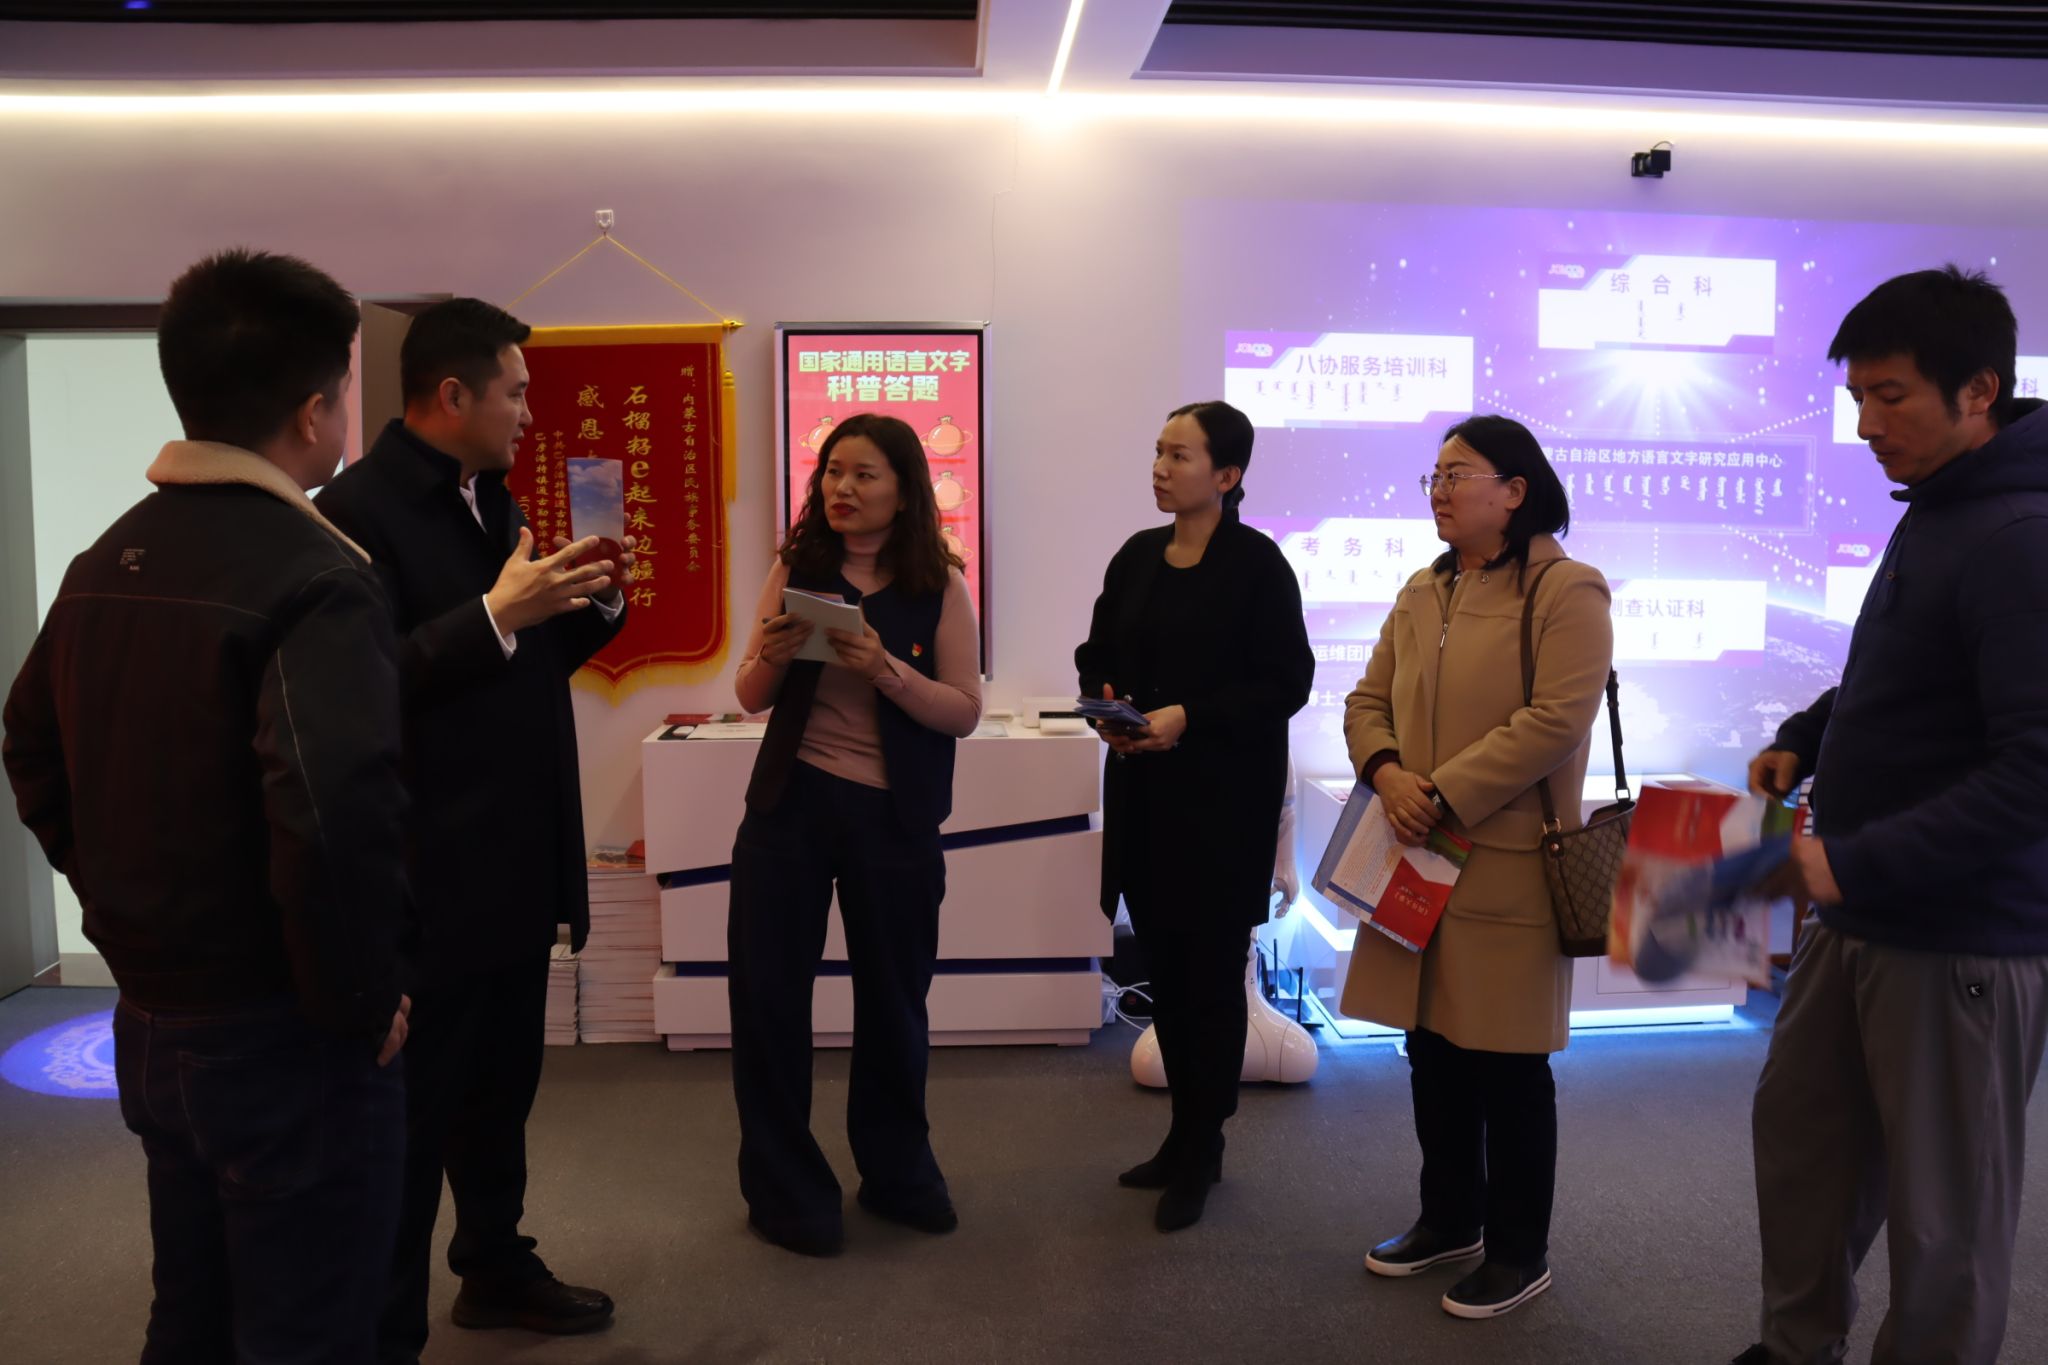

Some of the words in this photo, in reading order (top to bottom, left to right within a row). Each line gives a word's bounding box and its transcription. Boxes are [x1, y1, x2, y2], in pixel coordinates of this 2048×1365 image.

[1610, 273, 1713, 297] 综合科
[799, 350, 970, 373] 国家通用语言文字
[1295, 353, 1448, 379] 八协服务培训科
[827, 375, 939, 402] 科普答题
[1300, 536, 1405, 558] 考务科
